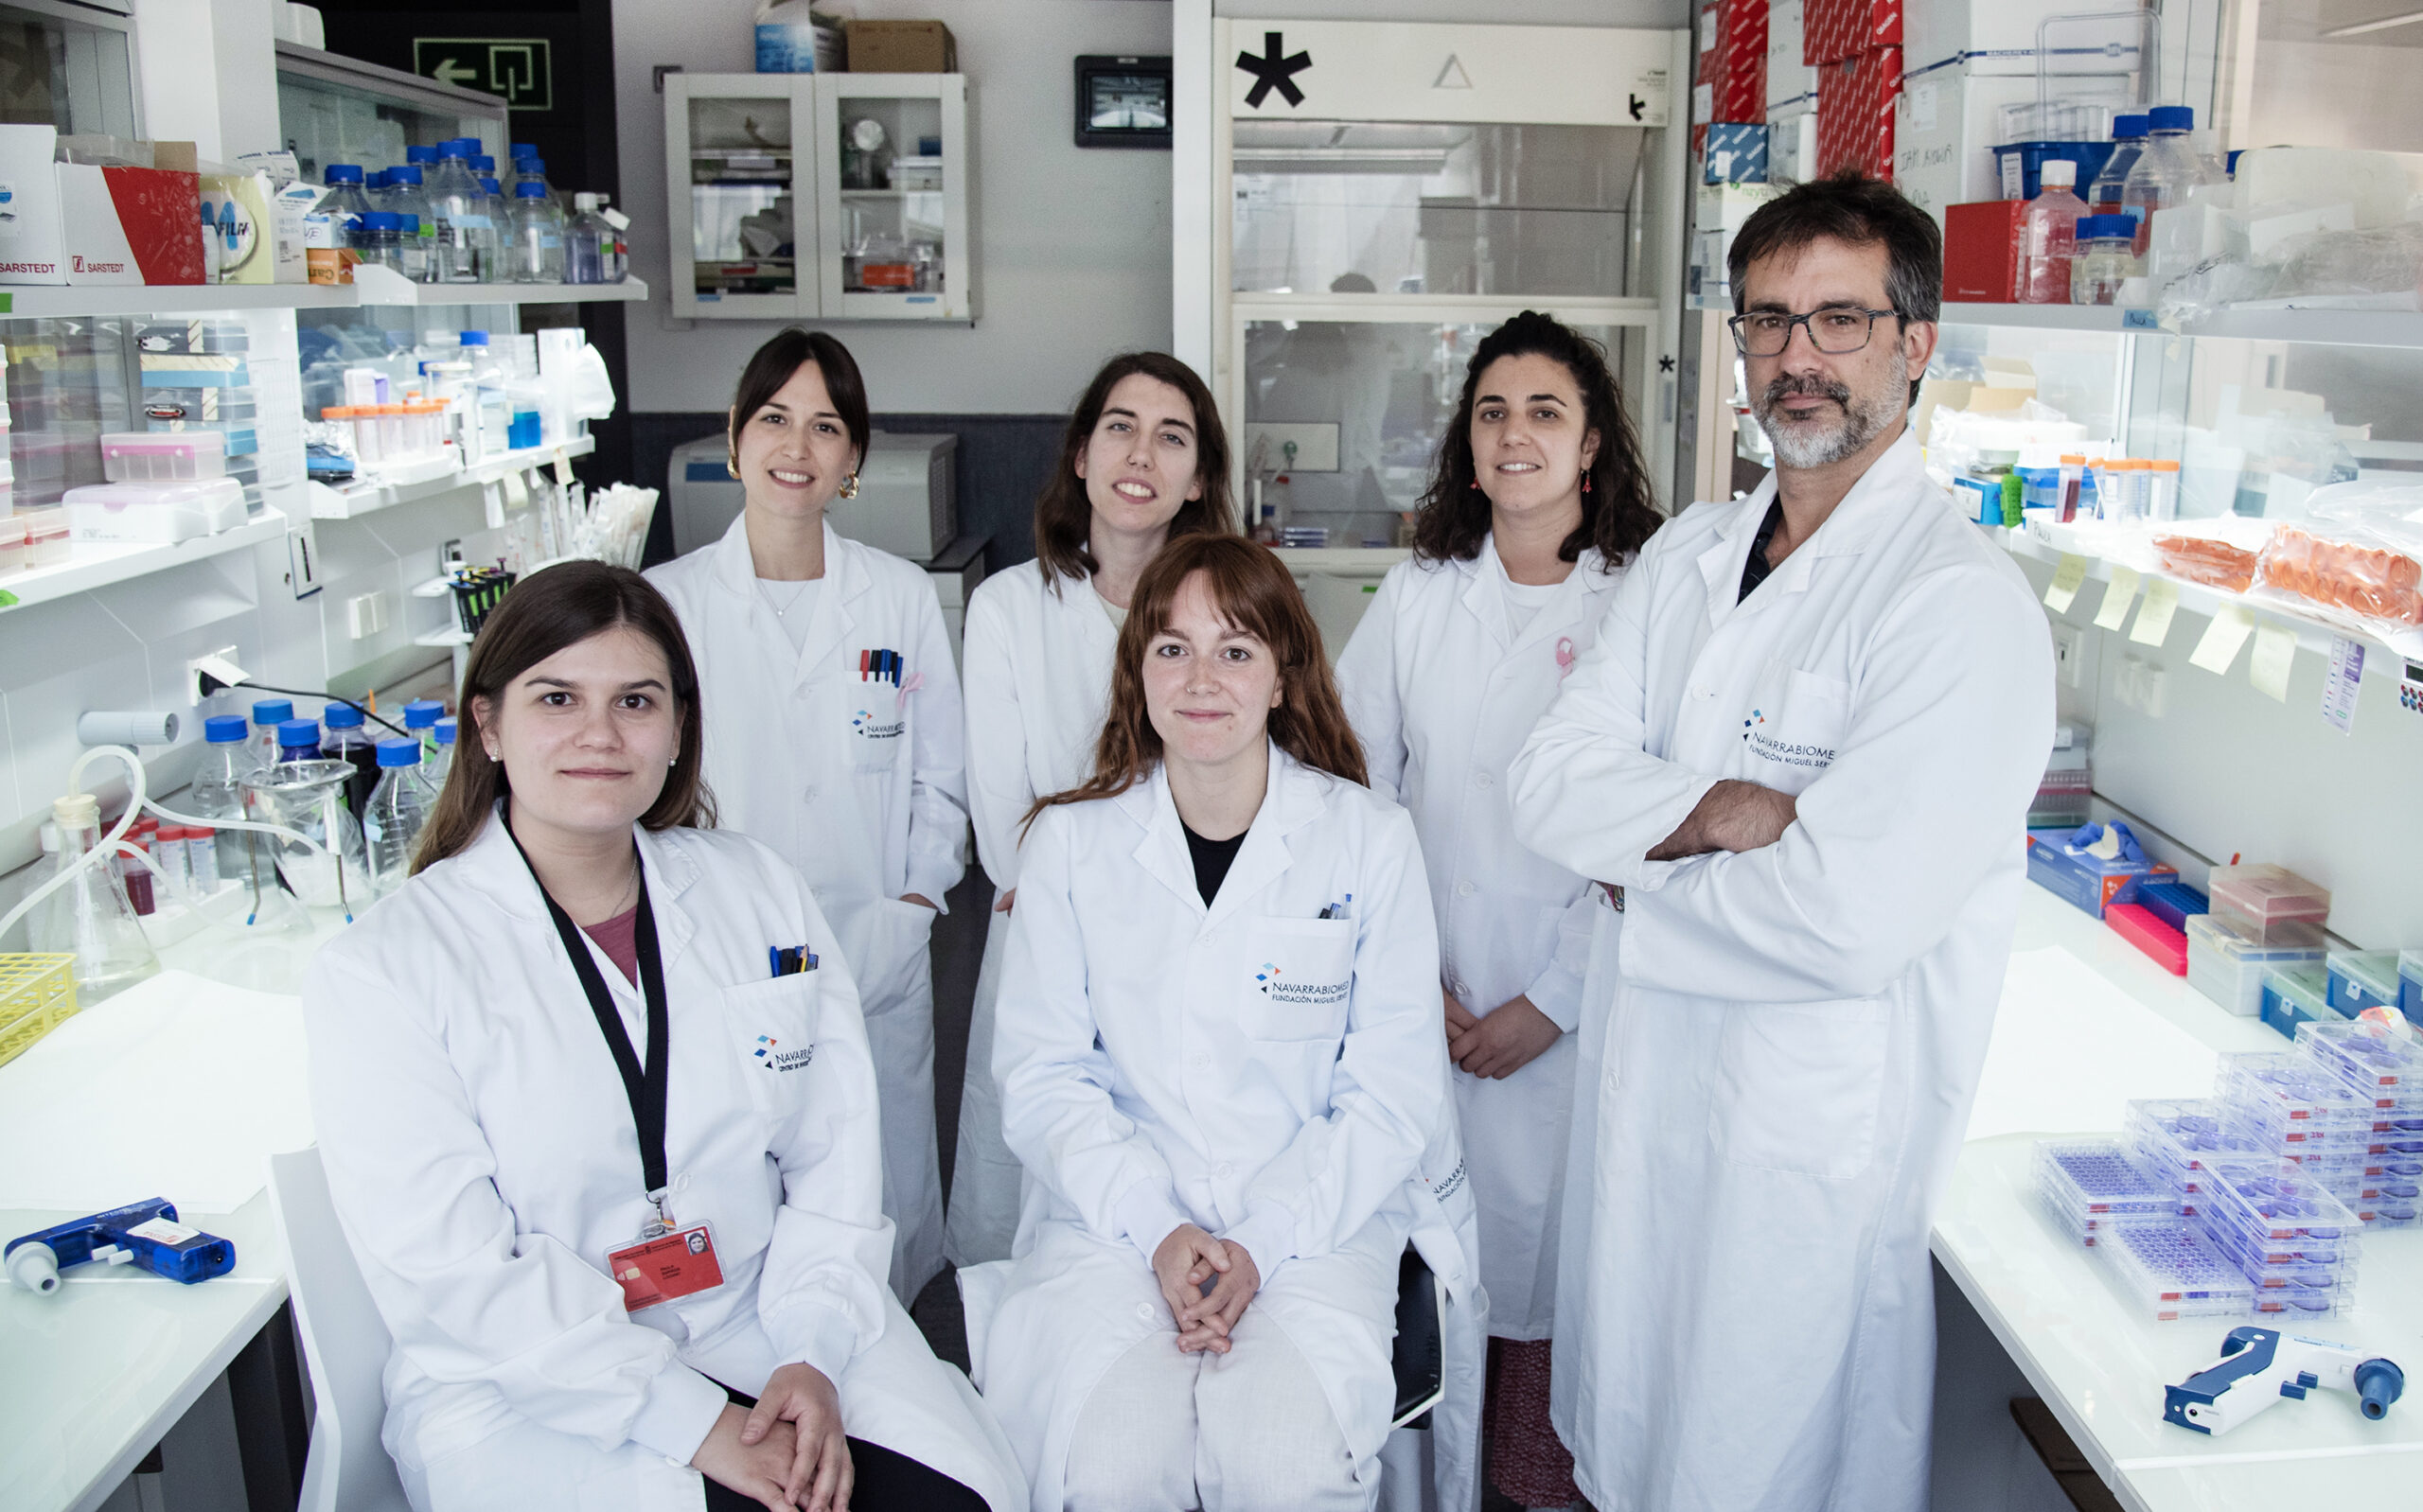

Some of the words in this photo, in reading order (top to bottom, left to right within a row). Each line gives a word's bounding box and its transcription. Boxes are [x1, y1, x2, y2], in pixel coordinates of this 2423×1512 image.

[0, 262, 56, 273] SARSTEDT
[87, 262, 125, 273] SARSTEDT
[1785, 757, 1813, 766] MIGUEL
[1272, 993, 1312, 1004] FUNDACIÓN
